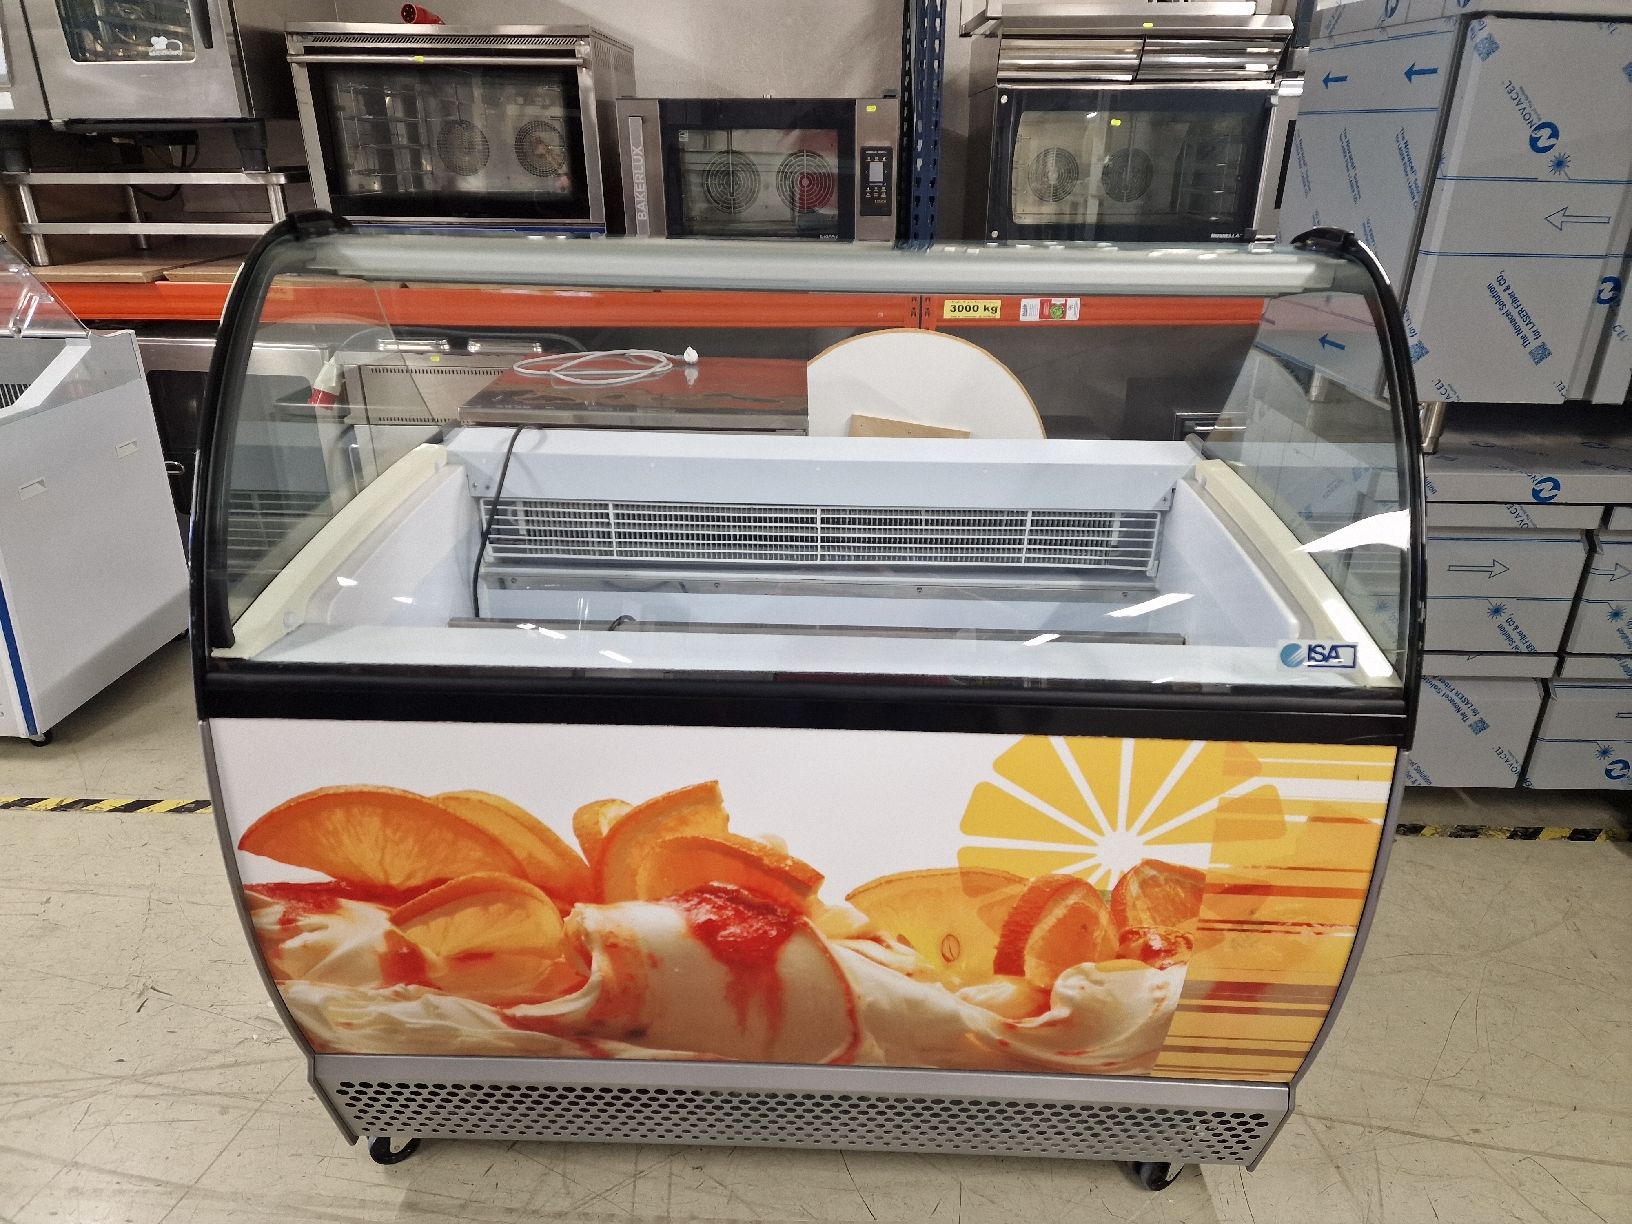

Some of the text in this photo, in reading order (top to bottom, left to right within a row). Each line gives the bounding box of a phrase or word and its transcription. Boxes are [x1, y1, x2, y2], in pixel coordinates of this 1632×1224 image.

[1505, 80, 1537, 129] NOVACEL
[632, 145, 647, 220] BAKERLUX
[1503, 284, 1511, 292] &
[950, 305, 998, 314] 3000 kg
[1507, 291, 1522, 309] Fiber
[1487, 283, 1531, 348] The Novacel Solution
[1518, 307, 1536, 330] LASER
[1532, 329, 1541, 340] for
[1434, 379, 1452, 401] ACEL
[1506, 503, 1528, 529] OVACE
[1308, 644, 1342, 663] ISA
